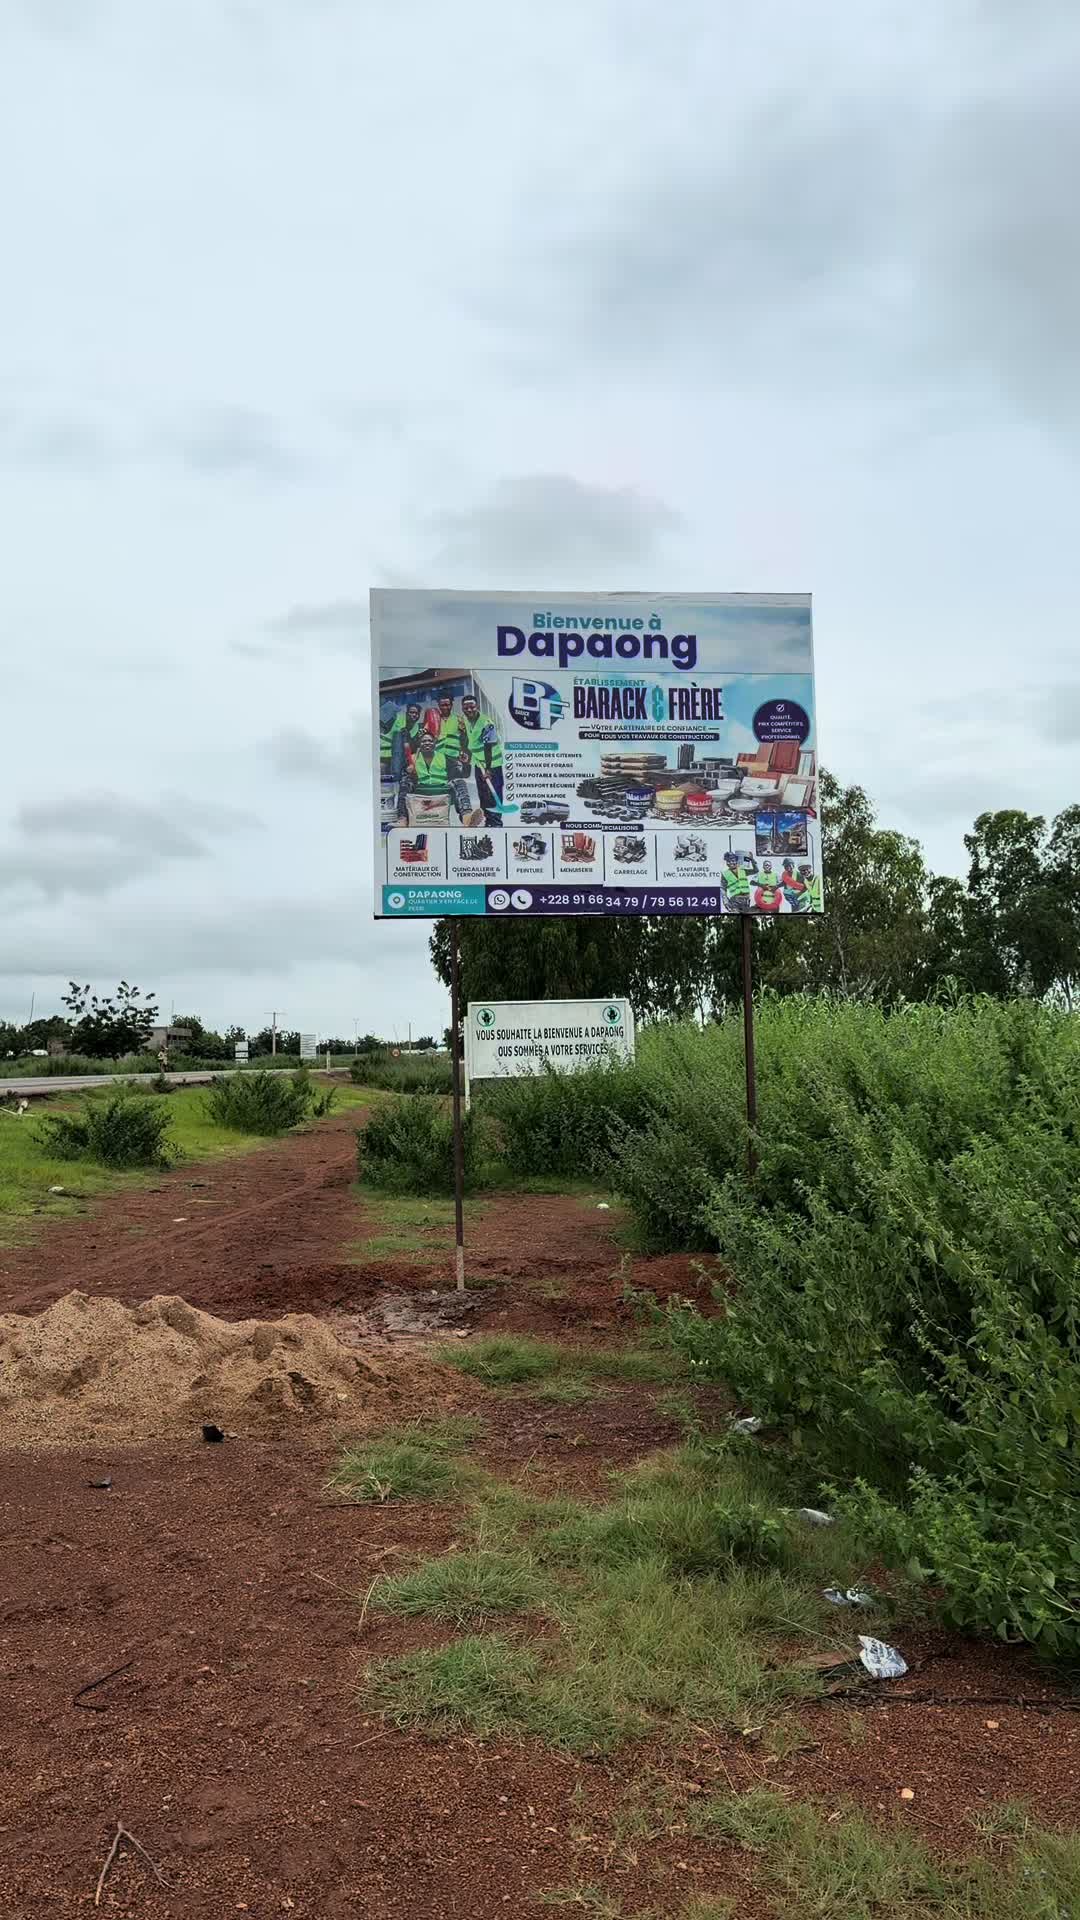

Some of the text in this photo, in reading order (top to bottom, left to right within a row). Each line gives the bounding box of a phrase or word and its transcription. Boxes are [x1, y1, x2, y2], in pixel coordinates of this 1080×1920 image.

[533, 612, 662, 630] Bienvenue à
[496, 625, 698, 670] Dapaong
[573, 676, 646, 687] ÉTABLISSEMENT
[573, 682, 724, 722] BARACK & FRÈRE
[583, 823, 639, 831] COMMERCIALISONS
[408, 890, 463, 898] DAPAONG
[539, 894, 717, 908] +228 91 66 34 79 / 79 56 12 49
[476, 1026, 624, 1041] VOUS SOUHAITE LA BIENVENUE A DAPAONG
[513, 1044, 543, 1056] SOMMES
[544, 1045, 549, 1056] A
[550, 1044, 574, 1056] VOTRE
[575, 1043, 608, 1055] SERVICES
